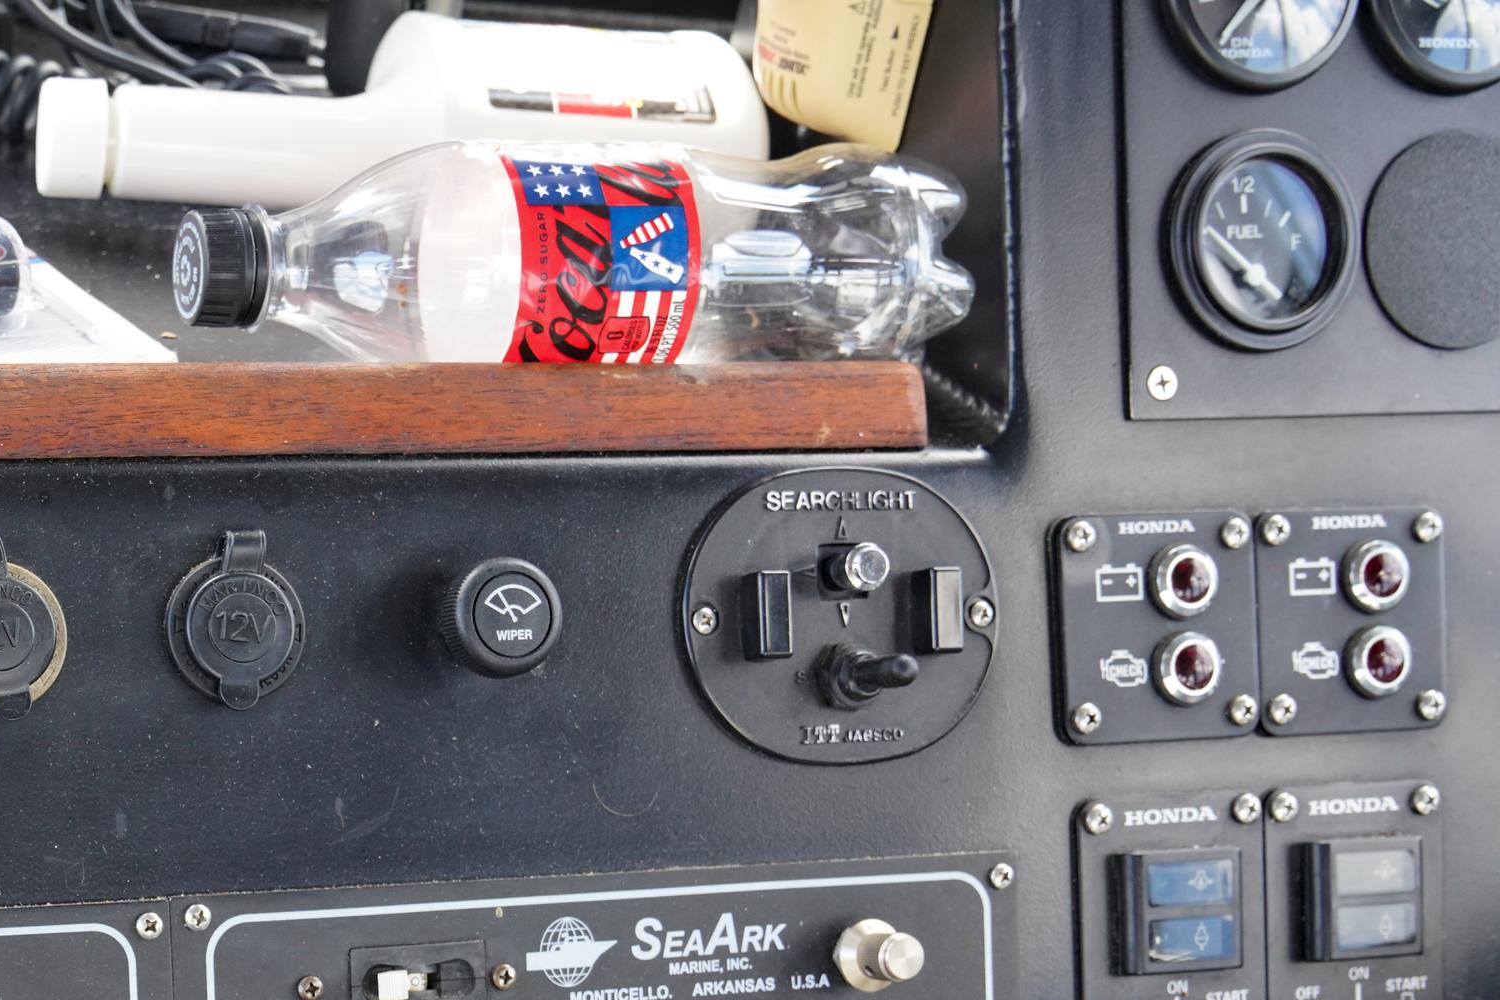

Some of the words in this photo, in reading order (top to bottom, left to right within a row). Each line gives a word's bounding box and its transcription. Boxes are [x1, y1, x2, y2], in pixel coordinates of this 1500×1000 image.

[1418, 37, 1479, 49] HONDA
[1231, 175, 1255, 193] 1/2
[537, 212, 549, 265] SUGAR
[1227, 224, 1263, 239] FUEL
[1290, 233, 1302, 250] F
[536, 273, 549, 314] ZERO
[664, 314, 681, 331] 500
[765, 490, 916, 512] SEARCHLIGHT
[1119, 520, 1194, 534] HONDA
[1313, 515, 1386, 529] HONDA
[199, 576, 287, 617] MARINCO
[215, 610, 274, 645] 12V
[497, 629, 532, 641] WIPER
[799, 723, 841, 745] ITT
[843, 727, 905, 743] JABSCO
[1310, 797, 1398, 815] HONDA
[1124, 806, 1217, 825] HONDA
[669, 960, 723, 975] MARINE,
[727, 957, 752, 970] INC.
[693, 977, 775, 996] ARKANSAS
[791, 974, 829, 989] U.S.A
[1167, 981, 1188, 994] ON
[1296, 986, 1319, 1000] OFF
[1349, 967, 1369, 980] ON
[1386, 976, 1427, 992] START
